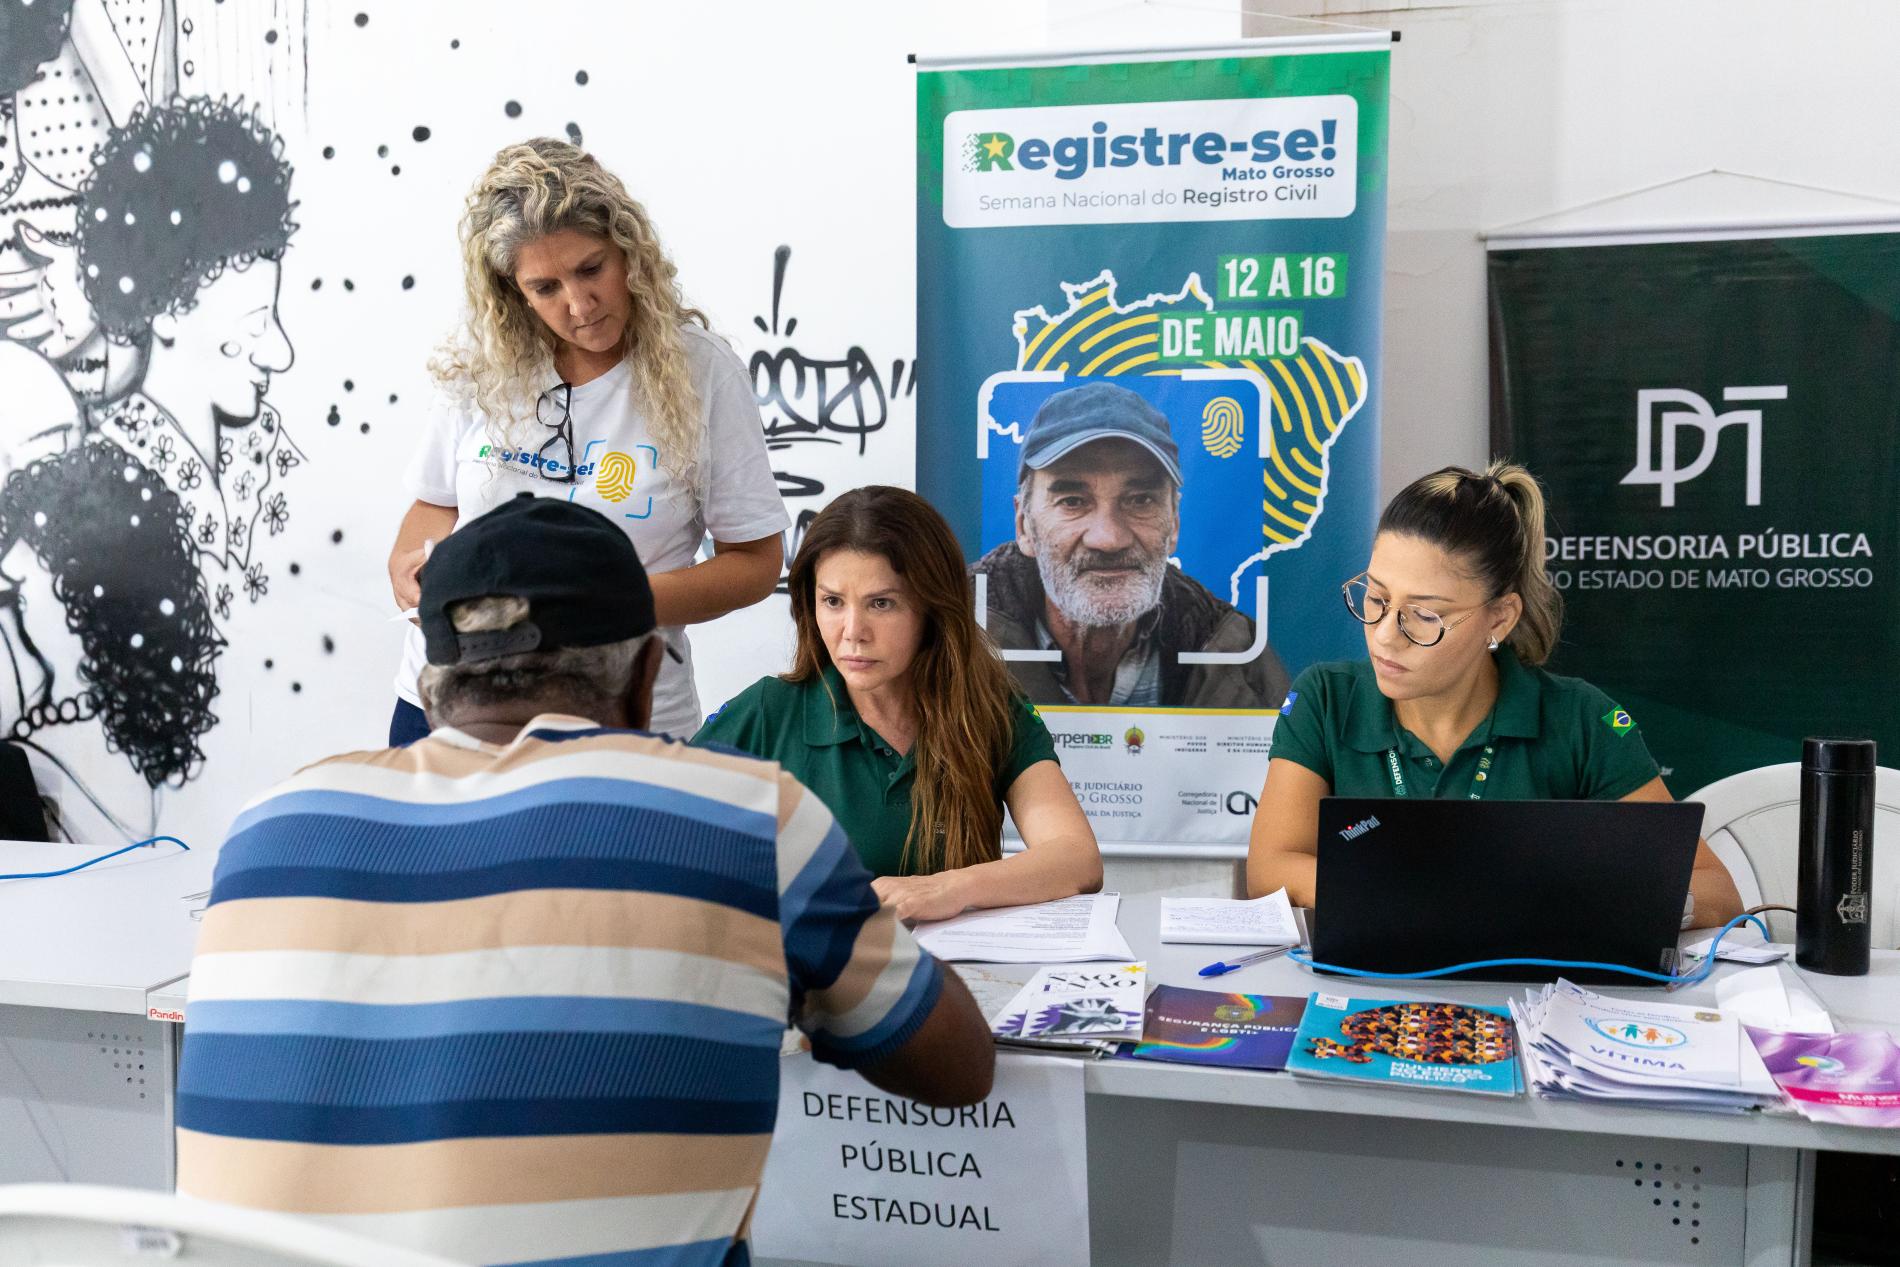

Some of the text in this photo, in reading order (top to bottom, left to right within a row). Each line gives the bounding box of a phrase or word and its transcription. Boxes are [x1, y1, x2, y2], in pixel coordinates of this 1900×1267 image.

[963, 119, 1338, 181] Registre-se!
[1222, 164, 1335, 182] Mato Grosso
[979, 184, 1318, 212] Semana Nacional do Registro Civil
[1224, 256, 1336, 299] 12 A 16
[1162, 316, 1299, 357] DE MAIO
[1543, 528, 1873, 561] DEFENSORIA PÚBLICA
[1578, 569, 1665, 591] ESTADO
[1670, 569, 1699, 590] DE
[1706, 568, 1770, 589] MATO
[1776, 567, 1873, 589] GROSSO
[1084, 781, 1143, 791] JUDICIÁRIO
[1178, 791, 1218, 799] Corregedoria
[1338, 814, 1381, 842] ThinkPad
[149, 1008, 184, 1021] Pandin
[802, 1091, 1017, 1129] DEFENSORIA
[840, 1140, 983, 1179] PÚBLICA
[832, 1193, 1001, 1232] ESTADUAL
